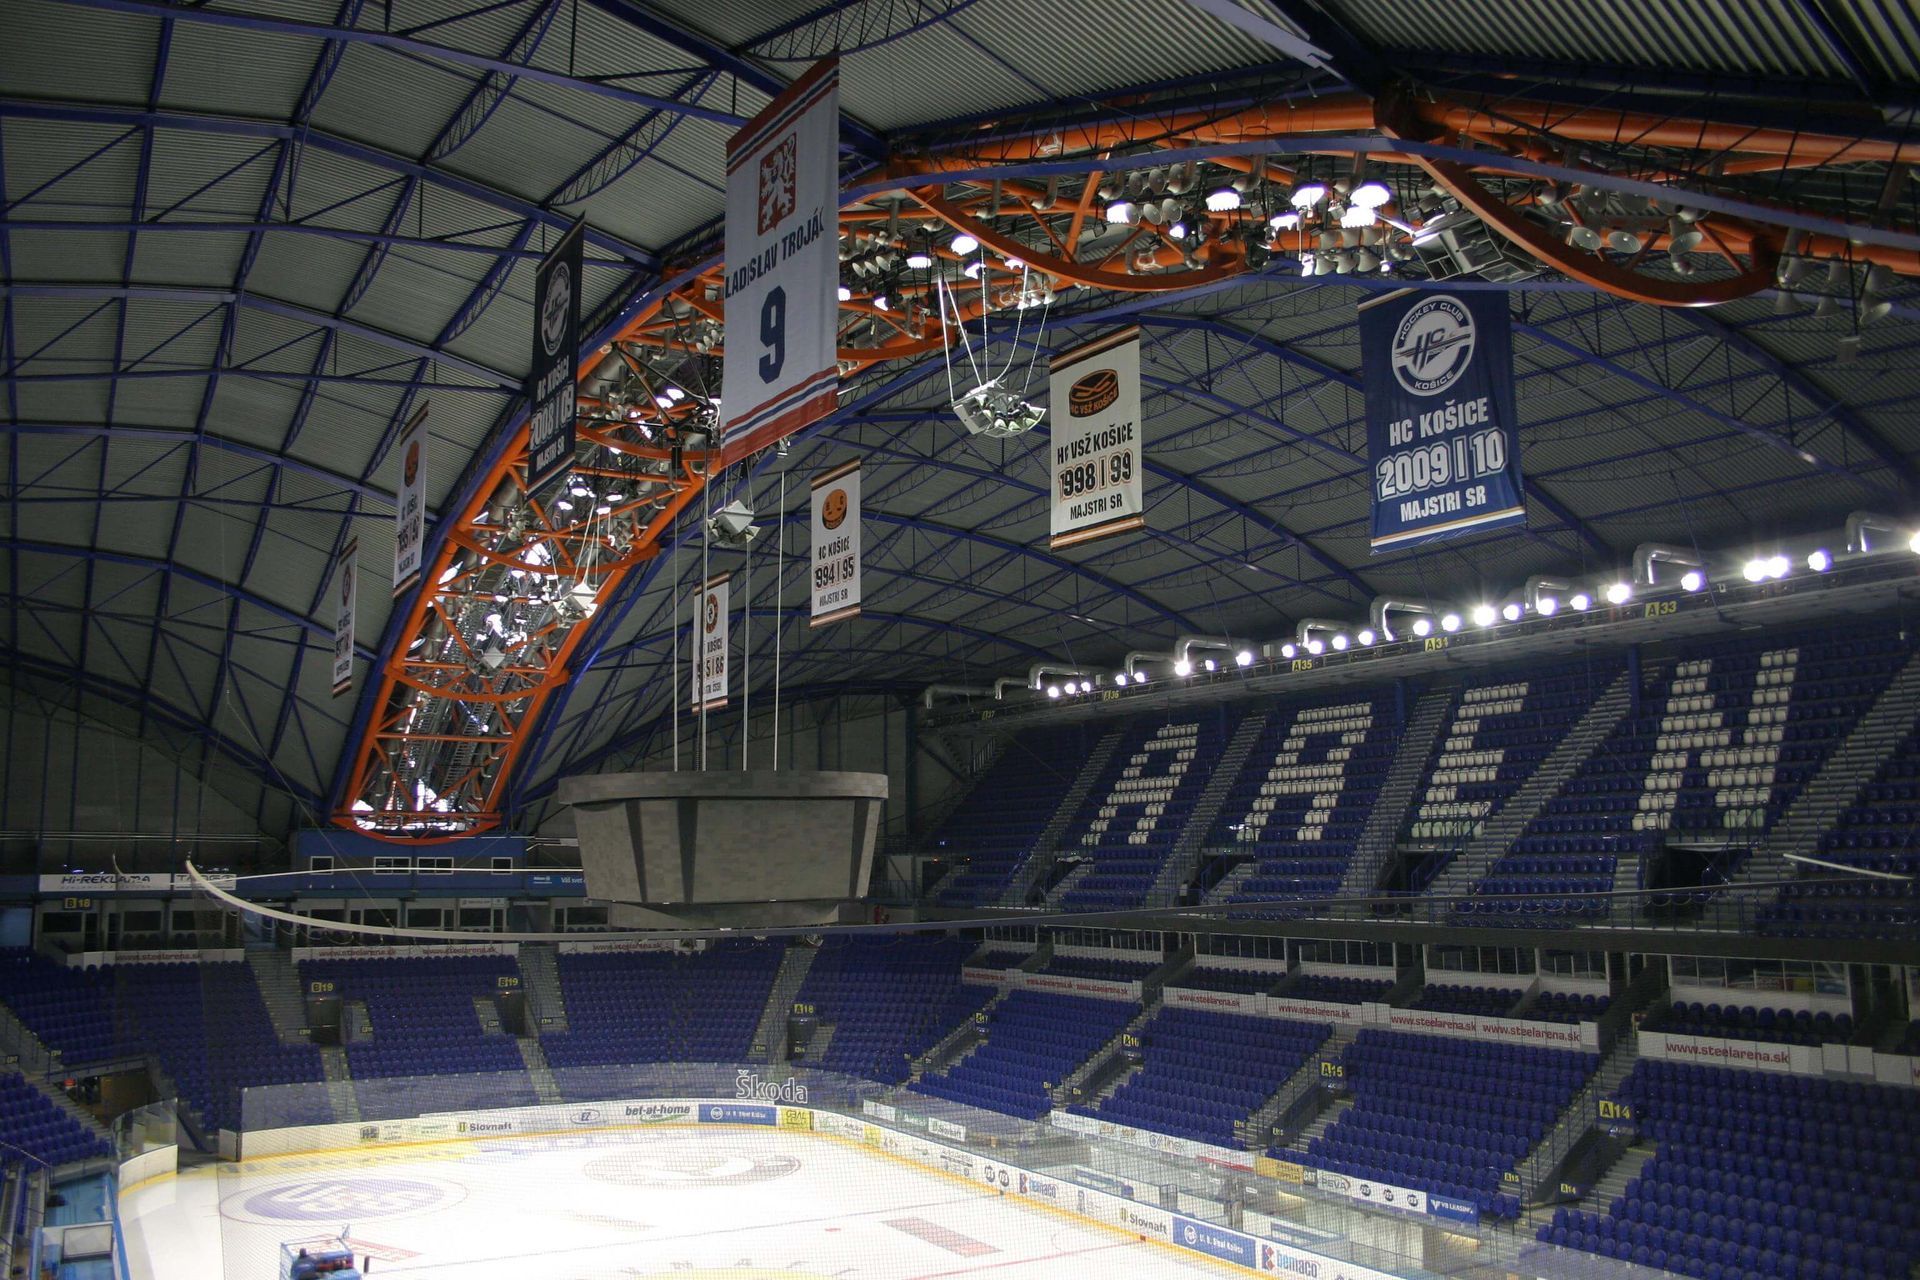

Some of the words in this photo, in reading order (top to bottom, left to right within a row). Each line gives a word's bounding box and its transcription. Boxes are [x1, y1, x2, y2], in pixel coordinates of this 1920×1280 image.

[725, 243, 778, 298] LADISLAV
[758, 285, 787, 384] 9
[1400, 302, 1437, 340] HOCKEY
[1440, 302, 1464, 321] CLUB
[1389, 418, 1413, 446] HC
[1420, 397, 1489, 439] KOŠICE
[1057, 446, 1068, 464] HC
[1071, 432, 1091, 460] VSŽ
[1093, 422, 1133, 452] KOŠICE
[1070, 499, 1107, 521] MAJSTRI
[1110, 493, 1123, 508] SR
[1401, 491, 1461, 521] MAJSTRI
[1466, 485, 1486, 507] SR
[828, 536, 850, 557] KOŠICE
[1178, 994, 1241, 1008] www.steelarena.sk
[1279, 1003, 1351, 1019] www.steelarena.sk
[1391, 1014, 1477, 1032] www.steelarena.sk
[1483, 1022, 1581, 1043] www.steelarena.sk
[1666, 1041, 1792, 1066] www.steelarena.sk
[736, 1069, 808, 1104] Škoda
[625, 1105, 691, 1116] bet-at-home
[470, 1121, 512, 1132] Slovnaft
[1129, 1213, 1167, 1234] Slovnaft
